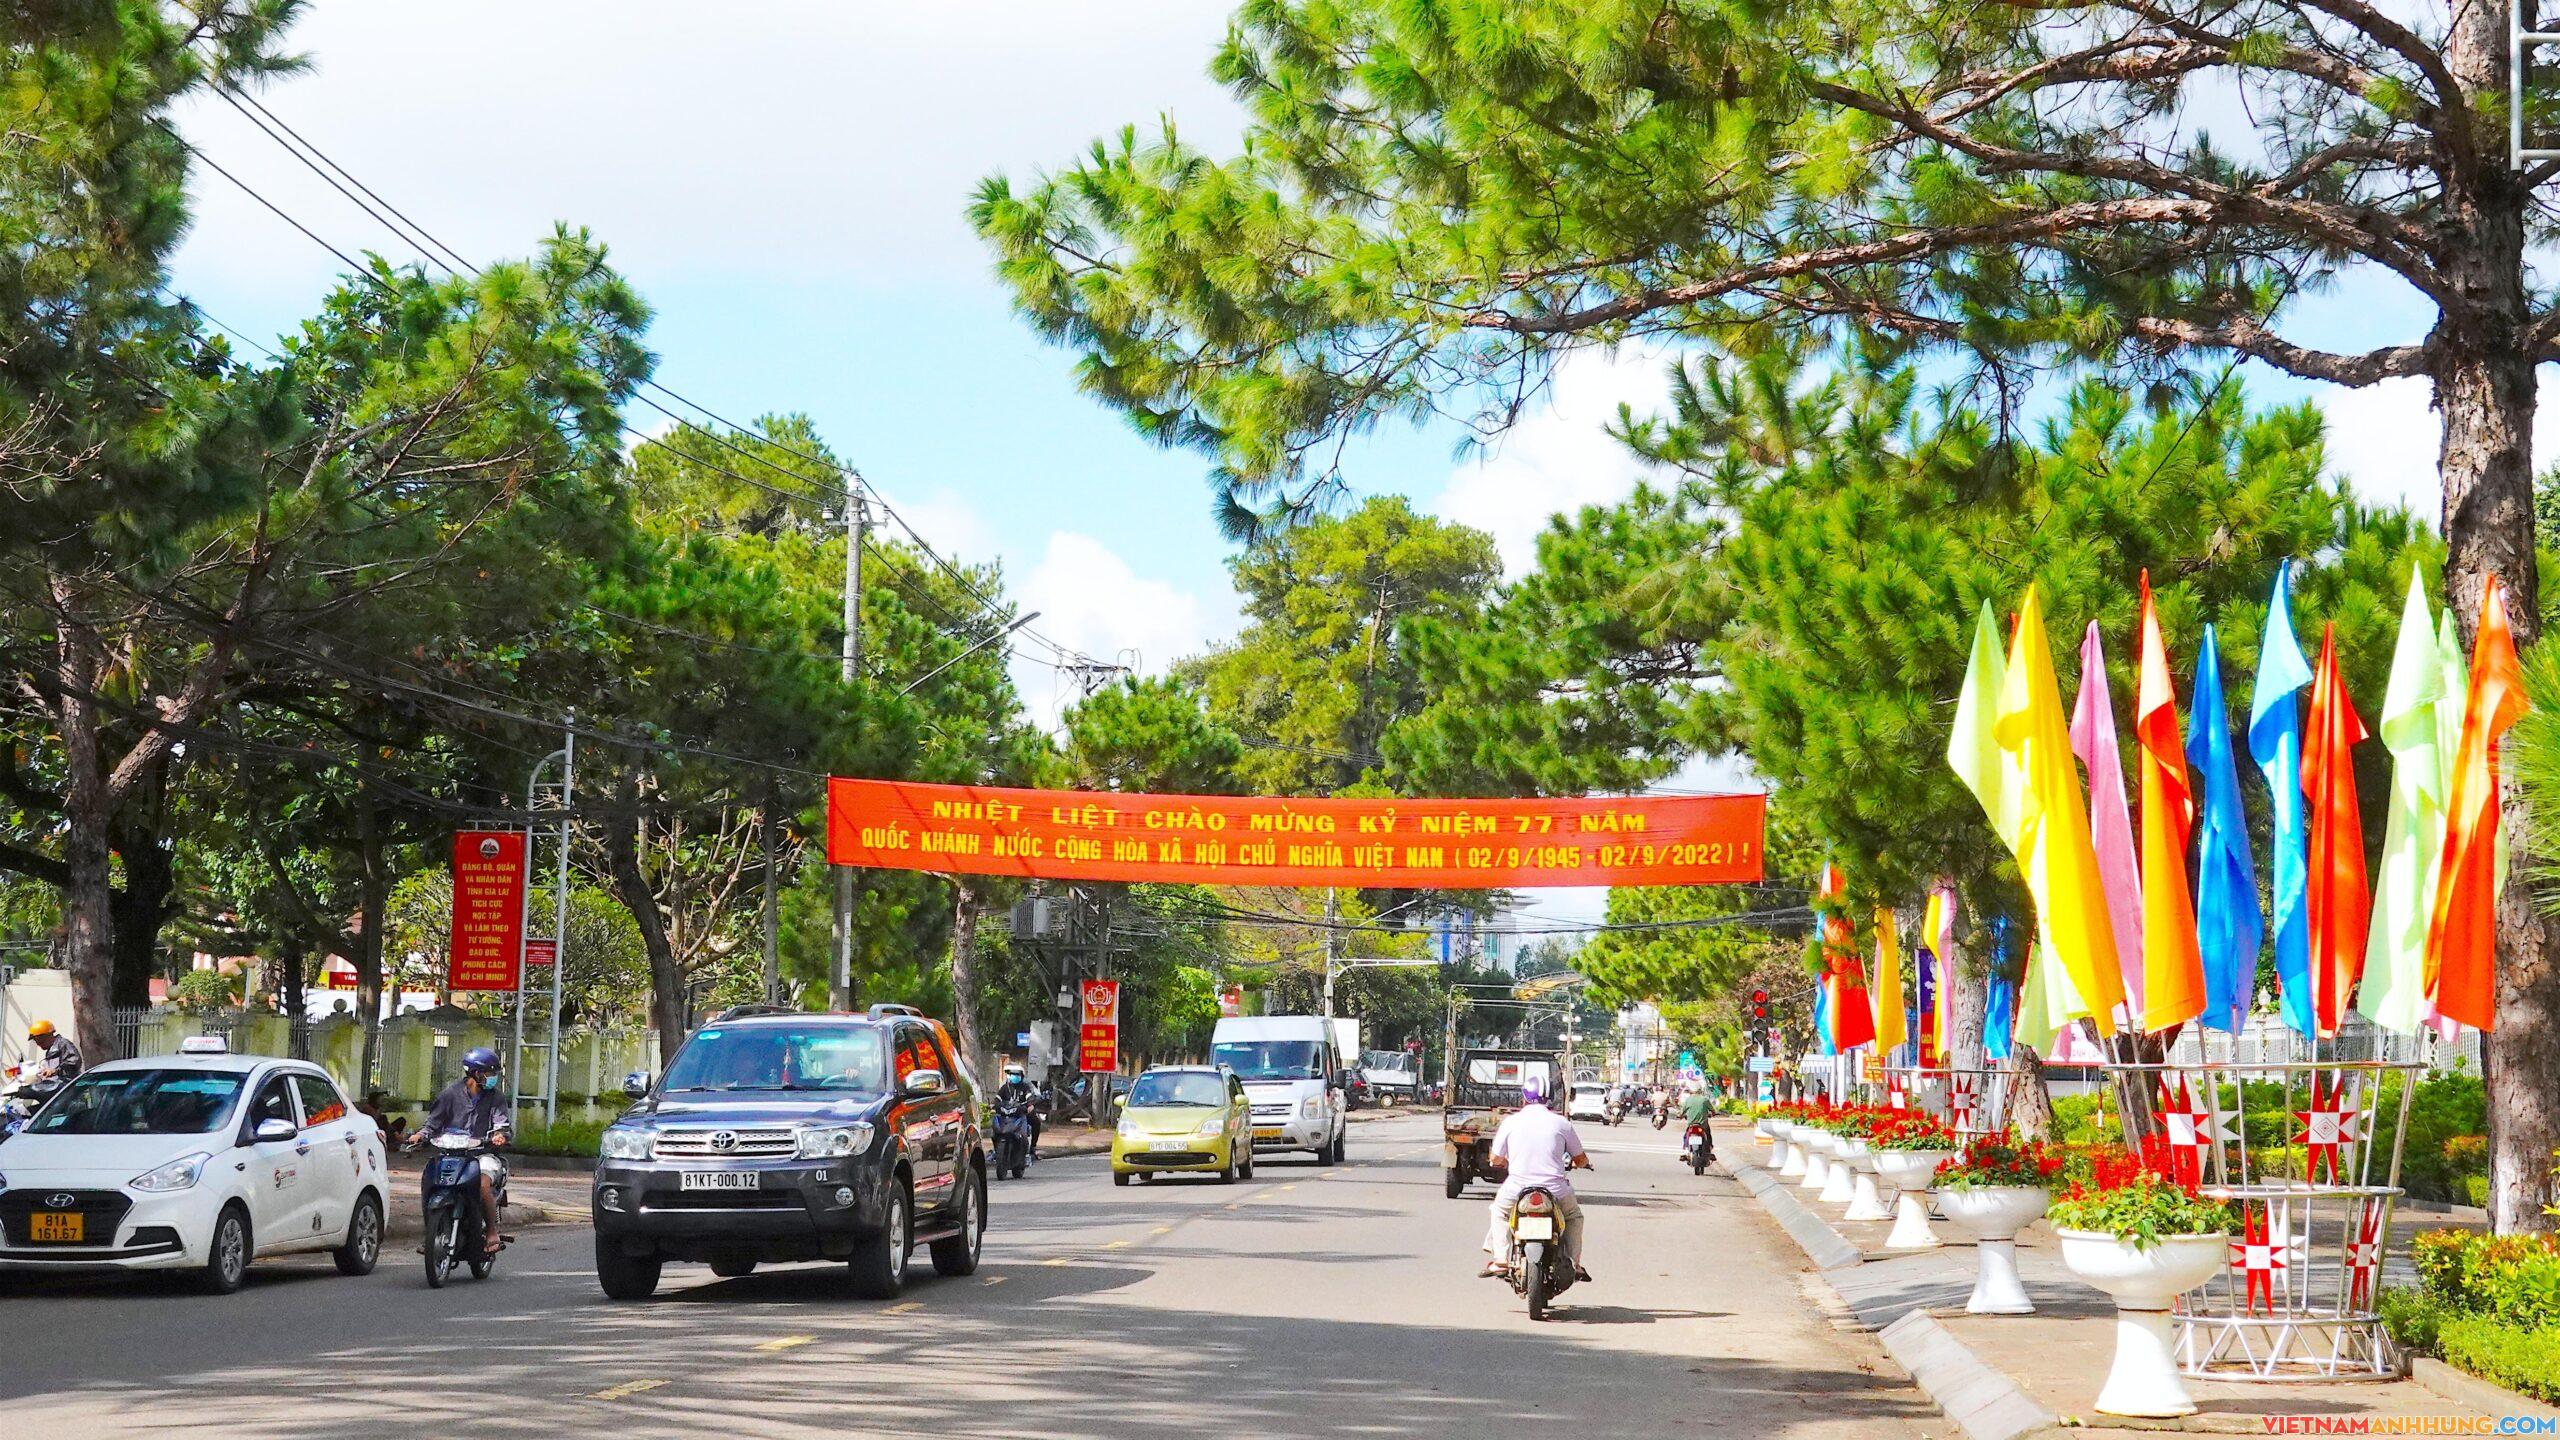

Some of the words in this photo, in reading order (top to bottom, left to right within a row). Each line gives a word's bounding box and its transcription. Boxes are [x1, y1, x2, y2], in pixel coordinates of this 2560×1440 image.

[933, 799, 1024, 825] NHIỆT
[1052, 803, 1120, 830] LIỆT
[1145, 805, 1226, 831] CHÀO
[1250, 804, 1335, 833] MỪNG
[1359, 807, 1397, 834] KỶ
[1421, 811, 1497, 838] NIỆM
[1513, 815, 1552, 833] 77
[1580, 809, 1646, 833] NĂM
[861, 820, 911, 850] QUỐC
[921, 826, 980, 855] KHÁNH
[993, 827, 1043, 859] NƯỚC
[1055, 835, 1101, 864] CỘNG
[1113, 836, 1148, 863] HÒA
[1158, 836, 1182, 864] XÃ
[1195, 839, 1226, 869] HỘI
[1239, 837, 1276, 866] CHỦ
[1289, 840, 1343, 868] NGHĨA
[1353, 842, 1395, 872] VIỆT
[1406, 847, 1443, 869] NAM
[685, 1173, 756, 1188] 81KT-000.12
[815, 1170, 828, 1181] 01
[45, 1215, 68, 1226] 81A
[37, 1227, 78, 1240] 161.67
